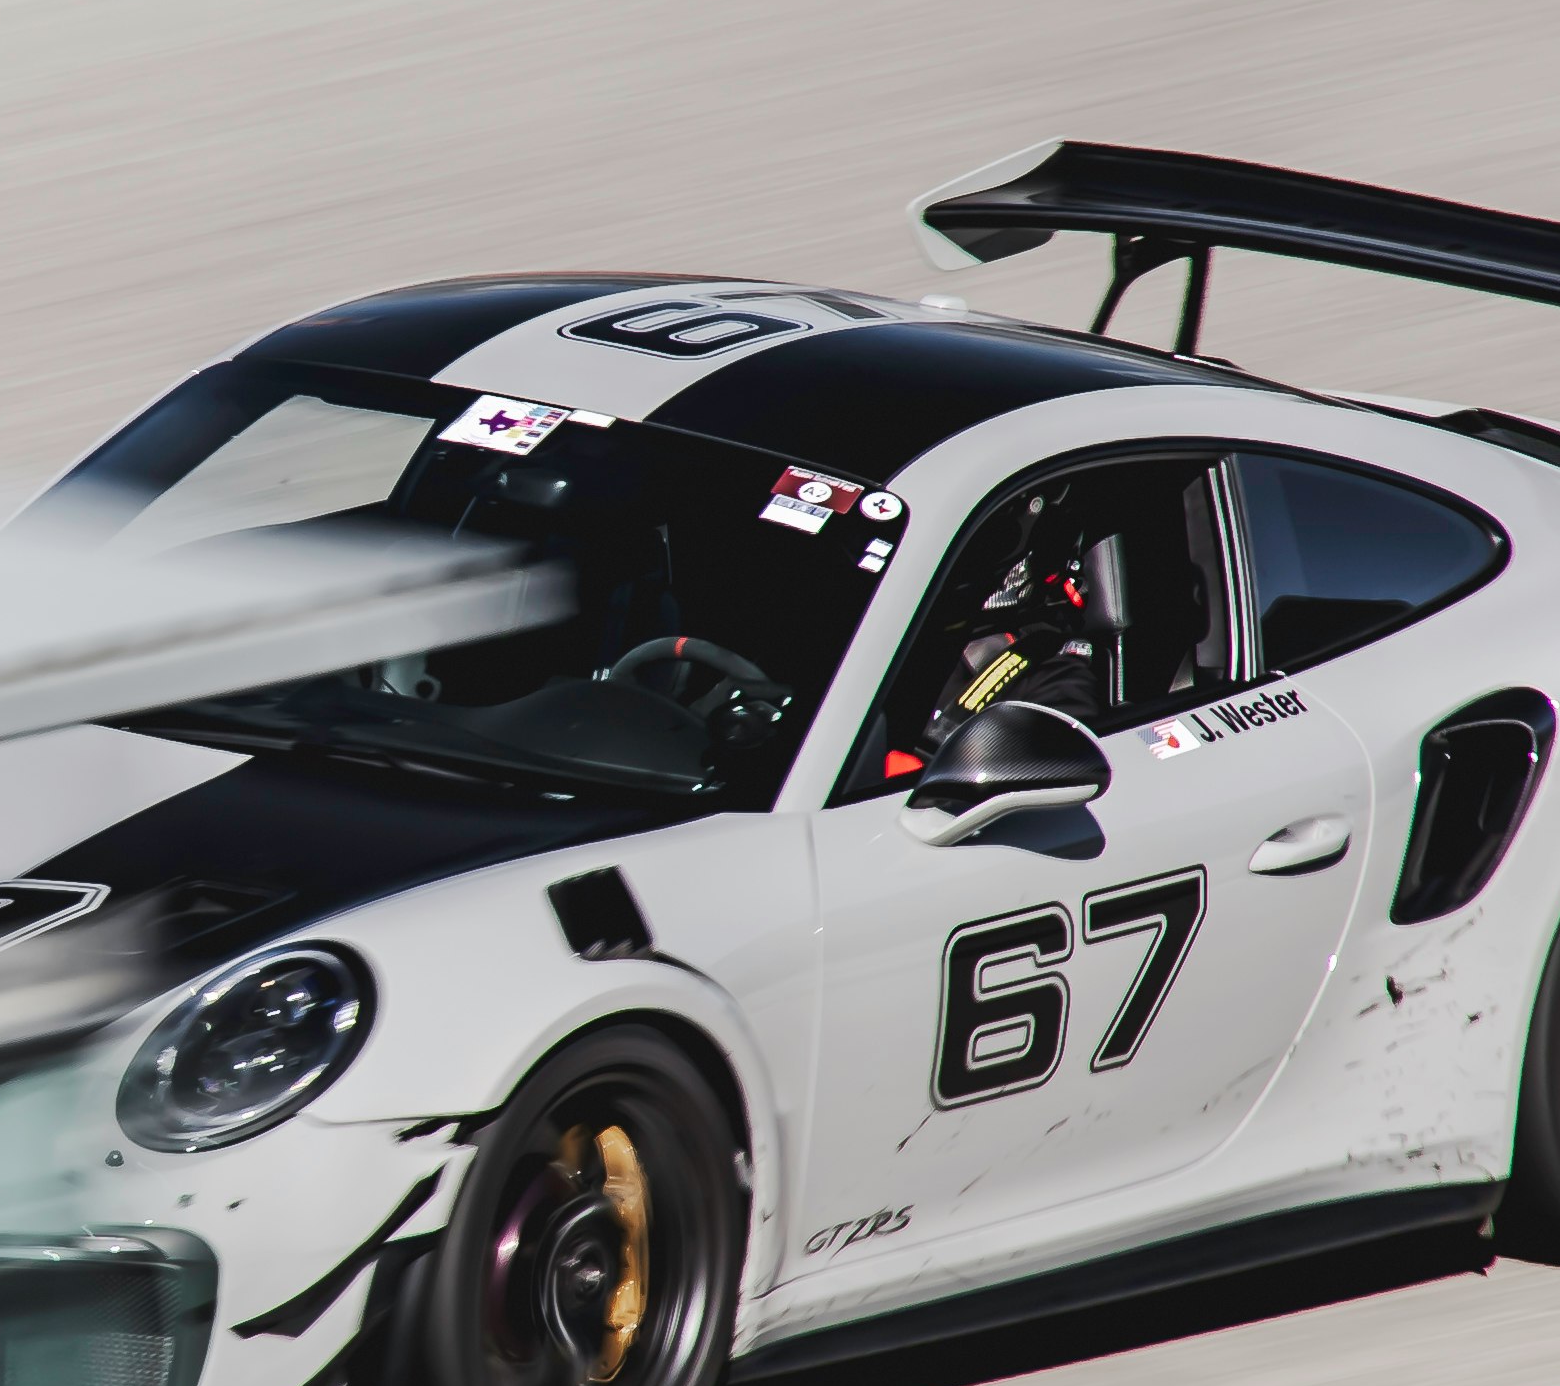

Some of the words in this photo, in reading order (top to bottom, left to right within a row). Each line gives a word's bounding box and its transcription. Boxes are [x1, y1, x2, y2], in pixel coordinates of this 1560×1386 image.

[556, 288, 904, 361] 67
[1190, 713, 1225, 743] J.
[1209, 689, 1309, 734] Wester
[929, 862, 1208, 1112] 67
